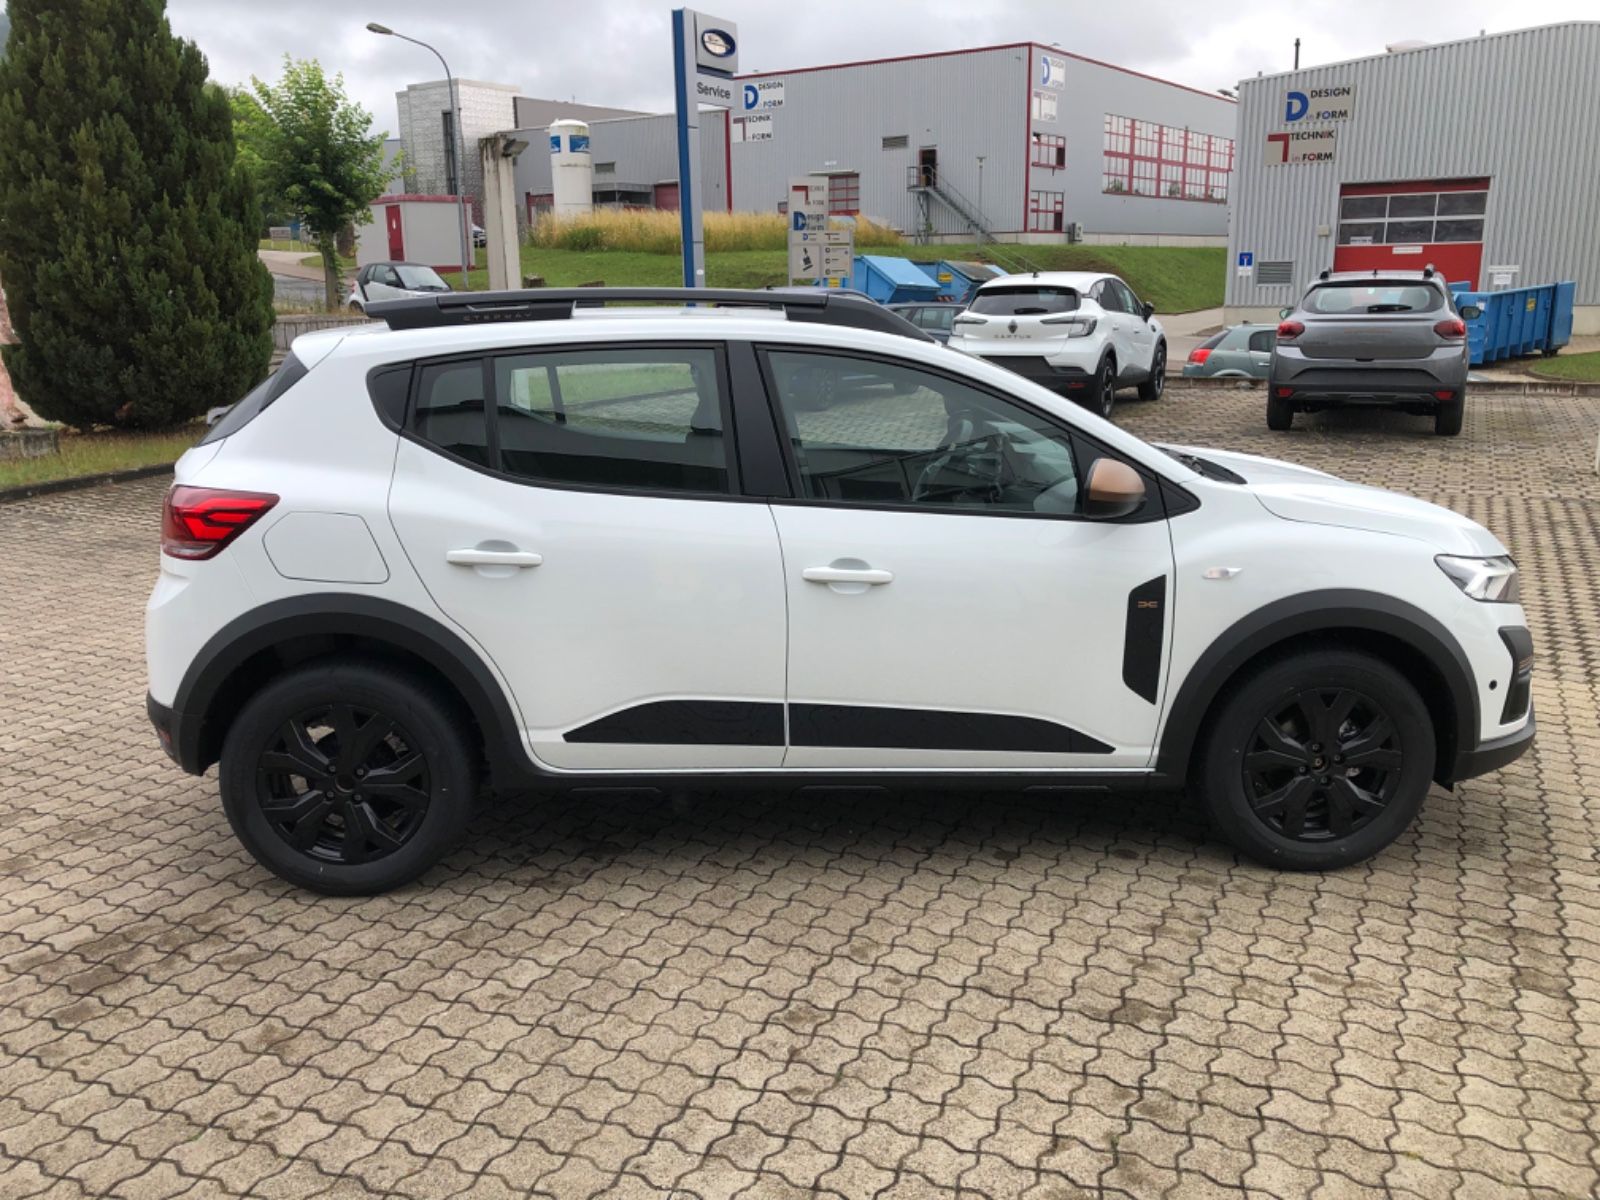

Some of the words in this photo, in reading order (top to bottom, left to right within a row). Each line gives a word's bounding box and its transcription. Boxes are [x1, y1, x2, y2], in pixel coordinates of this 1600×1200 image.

[697, 82, 731, 99] Service
[1286, 91, 1309, 122] D
[1310, 87, 1351, 98] DESIGN
[1316, 109, 1348, 120] FORM
[1290, 130, 1334, 140] TECHNIK
[1302, 152, 1333, 161] FORM
